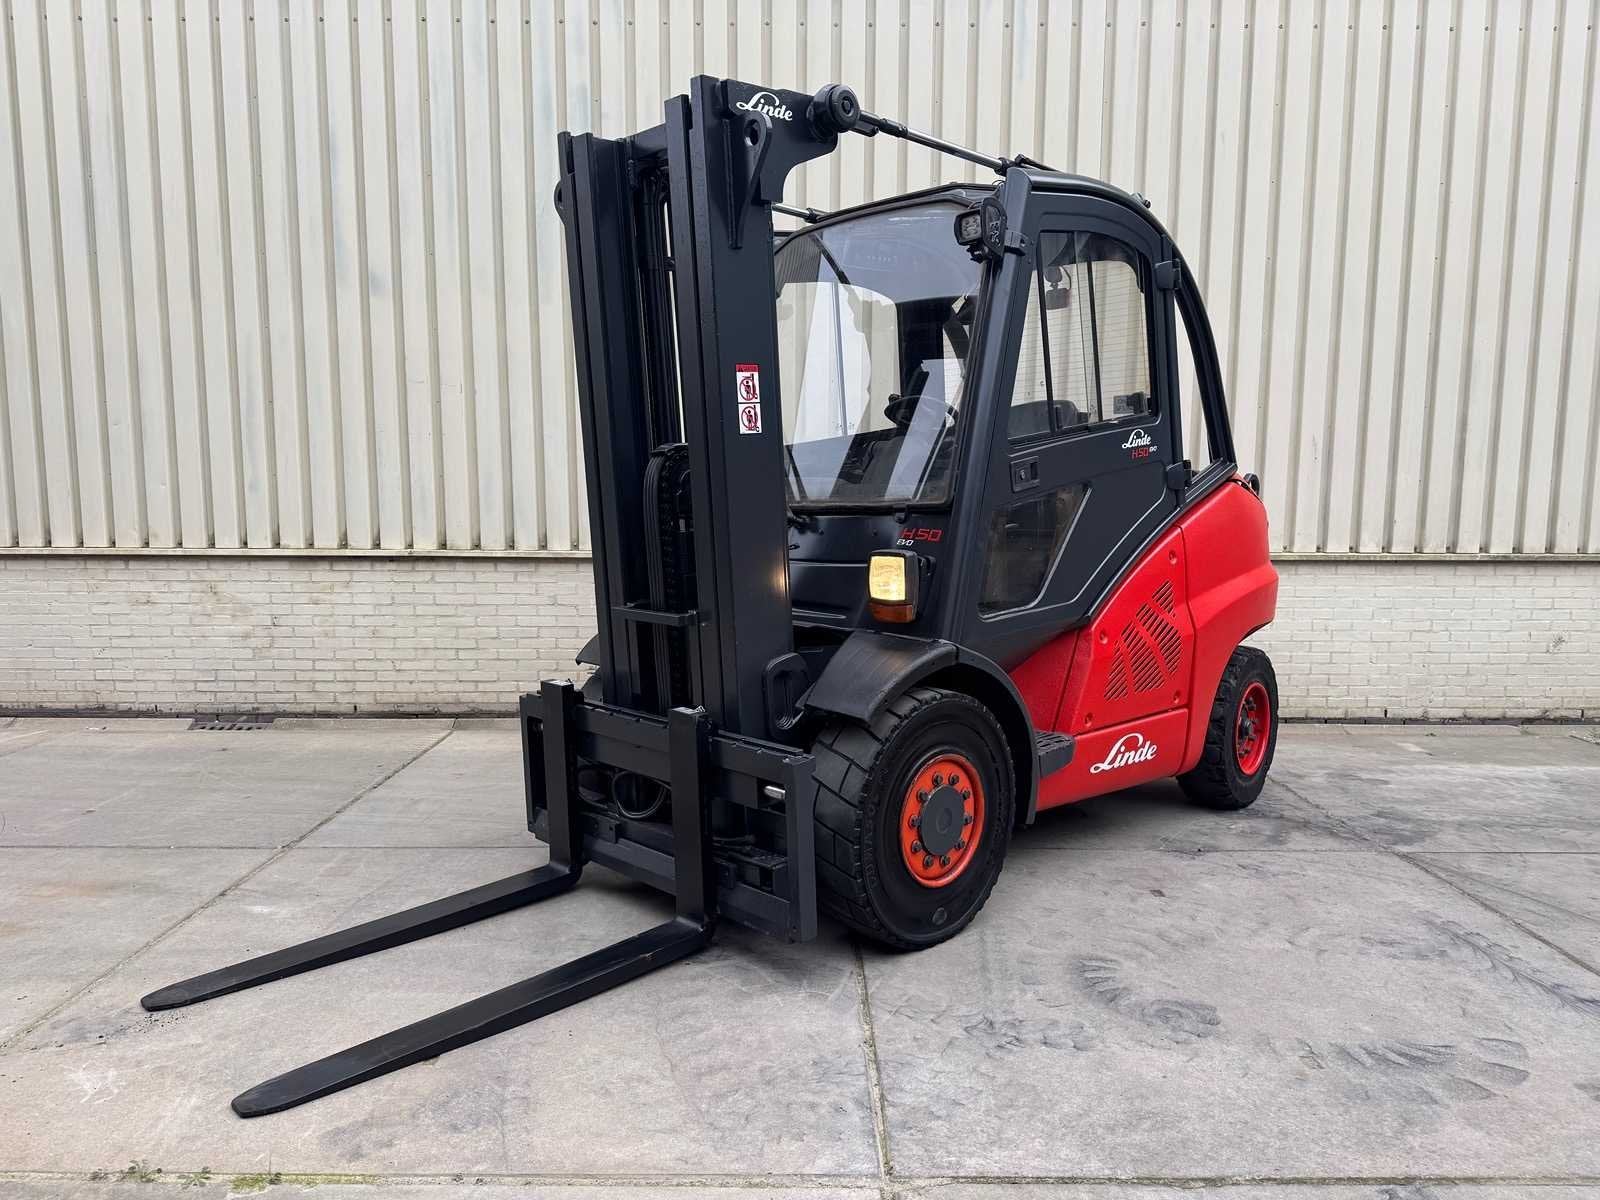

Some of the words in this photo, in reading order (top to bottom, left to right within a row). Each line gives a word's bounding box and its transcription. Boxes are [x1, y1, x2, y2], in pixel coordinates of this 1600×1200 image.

[736, 92, 793, 121] Linde
[1122, 429, 1152, 448] Linde
[1131, 447, 1149, 459] H50
[901, 527, 943, 542] H50
[1089, 732, 1158, 773] Linde
